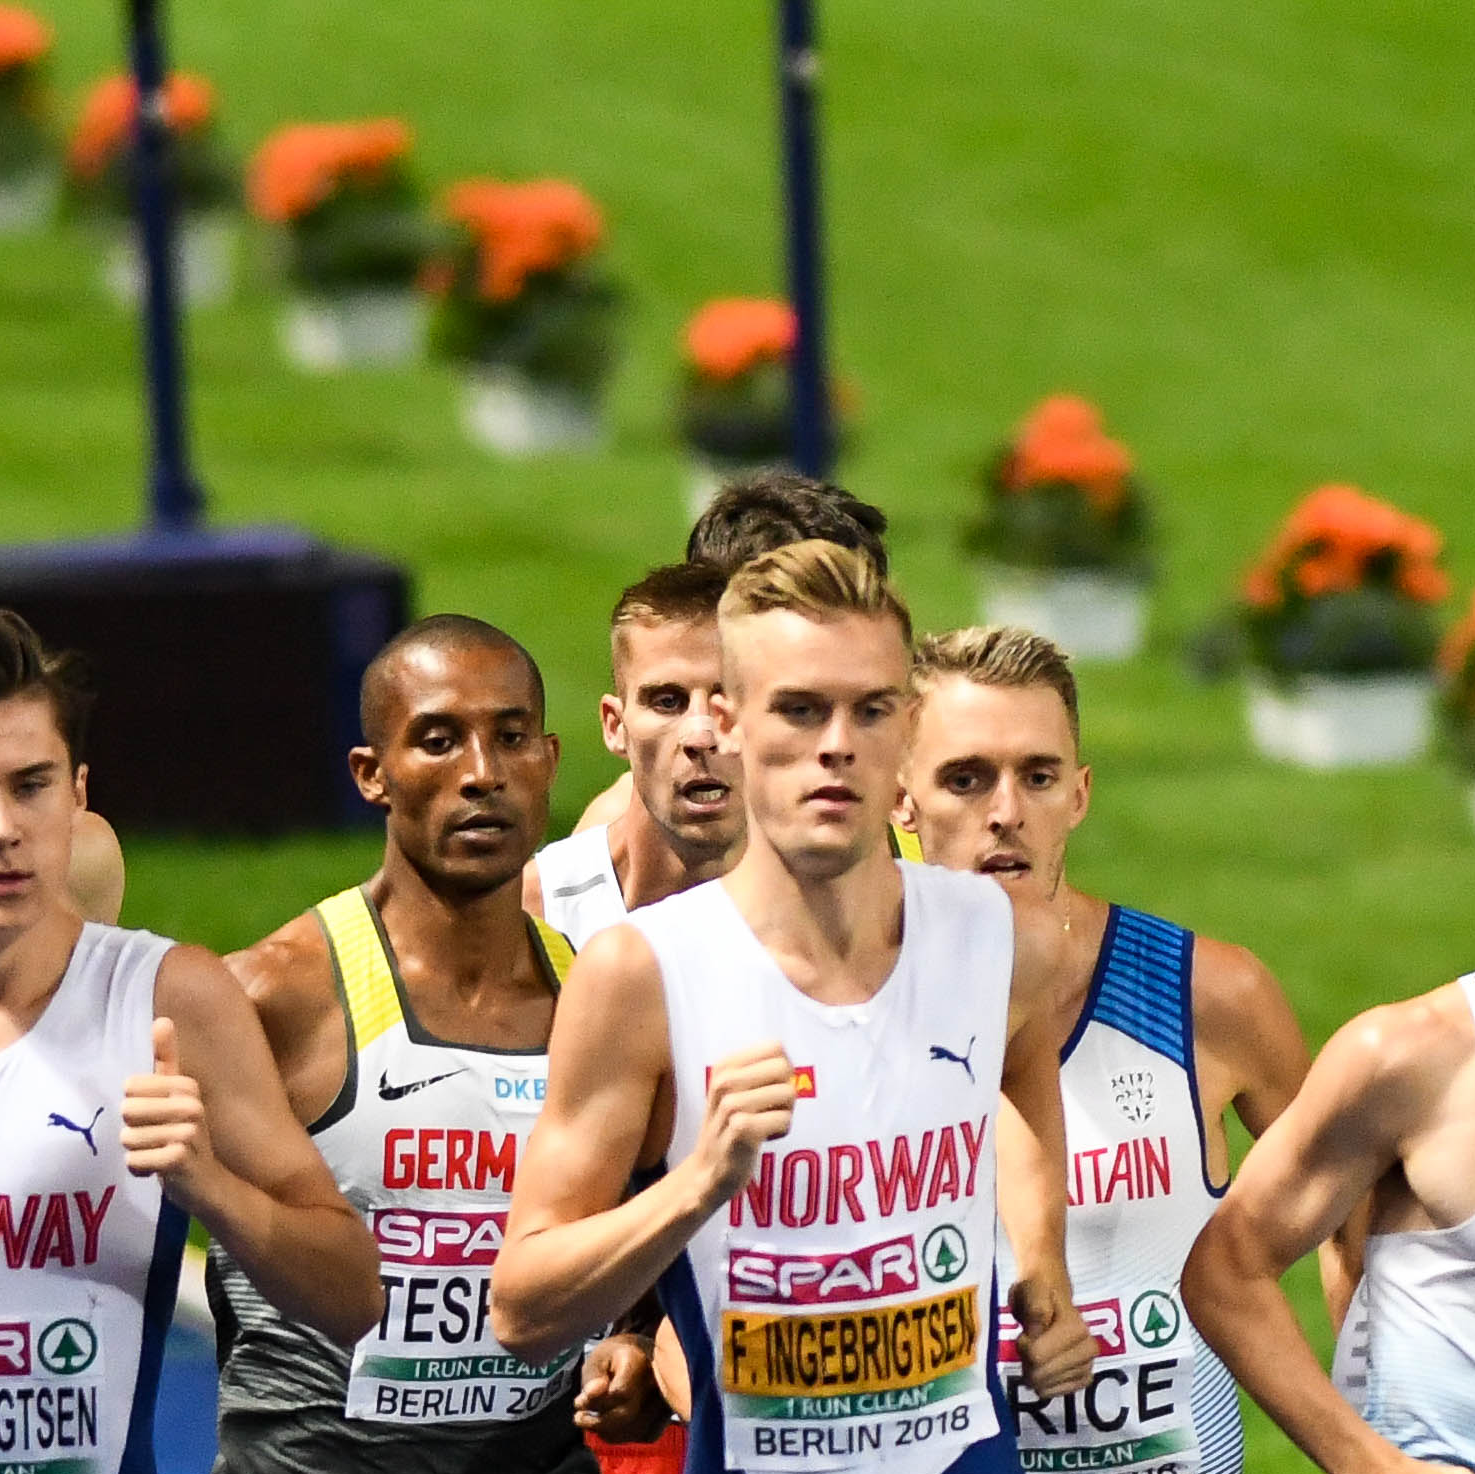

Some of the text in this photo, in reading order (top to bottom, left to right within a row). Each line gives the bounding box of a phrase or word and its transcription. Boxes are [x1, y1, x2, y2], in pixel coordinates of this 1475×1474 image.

[495, 1077, 546, 1100] DKB
[383, 1128, 516, 1192] GERM
[728, 1114, 988, 1228] NORWAY
[1068, 1136, 1171, 1206] ITAIN
[378, 1214, 504, 1258] SPA
[733, 1247, 915, 1298] SPAR
[731, 1320, 757, 1384] F.
[767, 1300, 977, 1386] INGEBRIGTSEN
[415, 1360, 421, 1379] I
[428, 1359, 474, 1378] RUN
[376, 1385, 496, 1417] BERLIN
[801, 1396, 852, 1416] RUN
[1007, 1359, 1178, 1437] RICE
[755, 1407, 970, 1456] BERLIN 2018
[1020, 1454, 1053, 1470] UN
